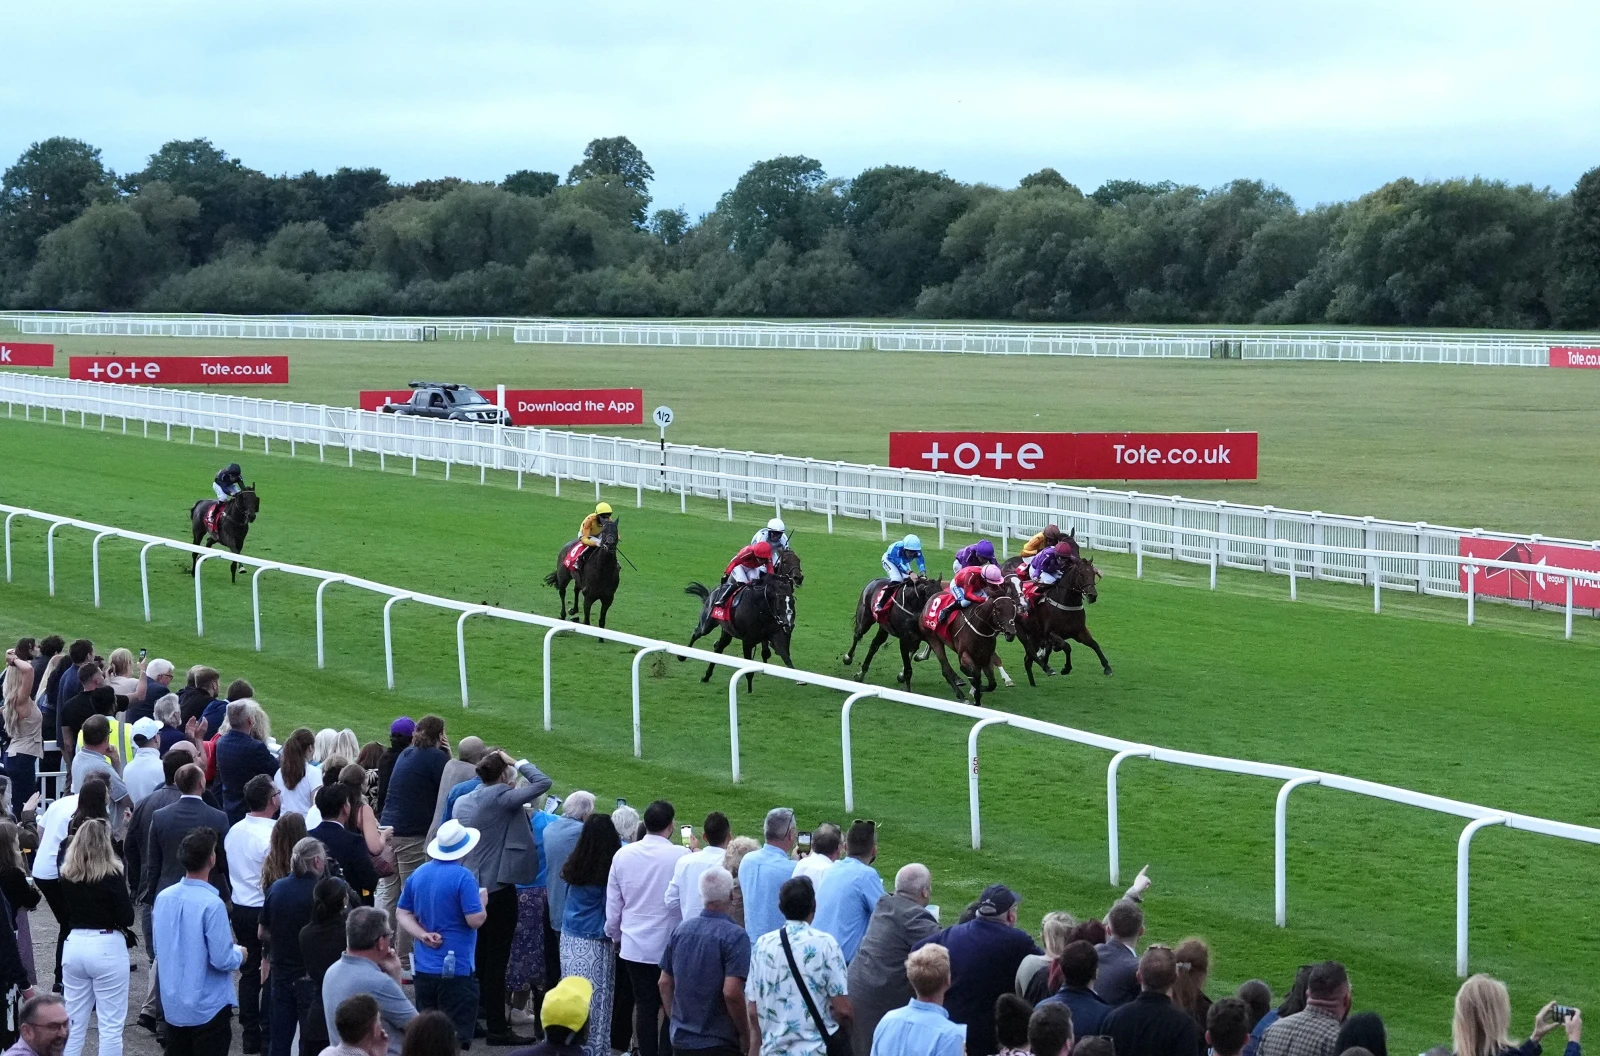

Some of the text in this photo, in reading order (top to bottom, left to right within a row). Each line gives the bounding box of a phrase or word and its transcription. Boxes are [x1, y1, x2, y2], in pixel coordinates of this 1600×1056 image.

[201, 363, 272, 376] Tote.co.uk
[518, 400, 635, 414] Download the App
[656, 410, 671, 423] 1/2
[1113, 444, 1231, 465] Tote.co.uk
[929, 597, 941, 617] 9
